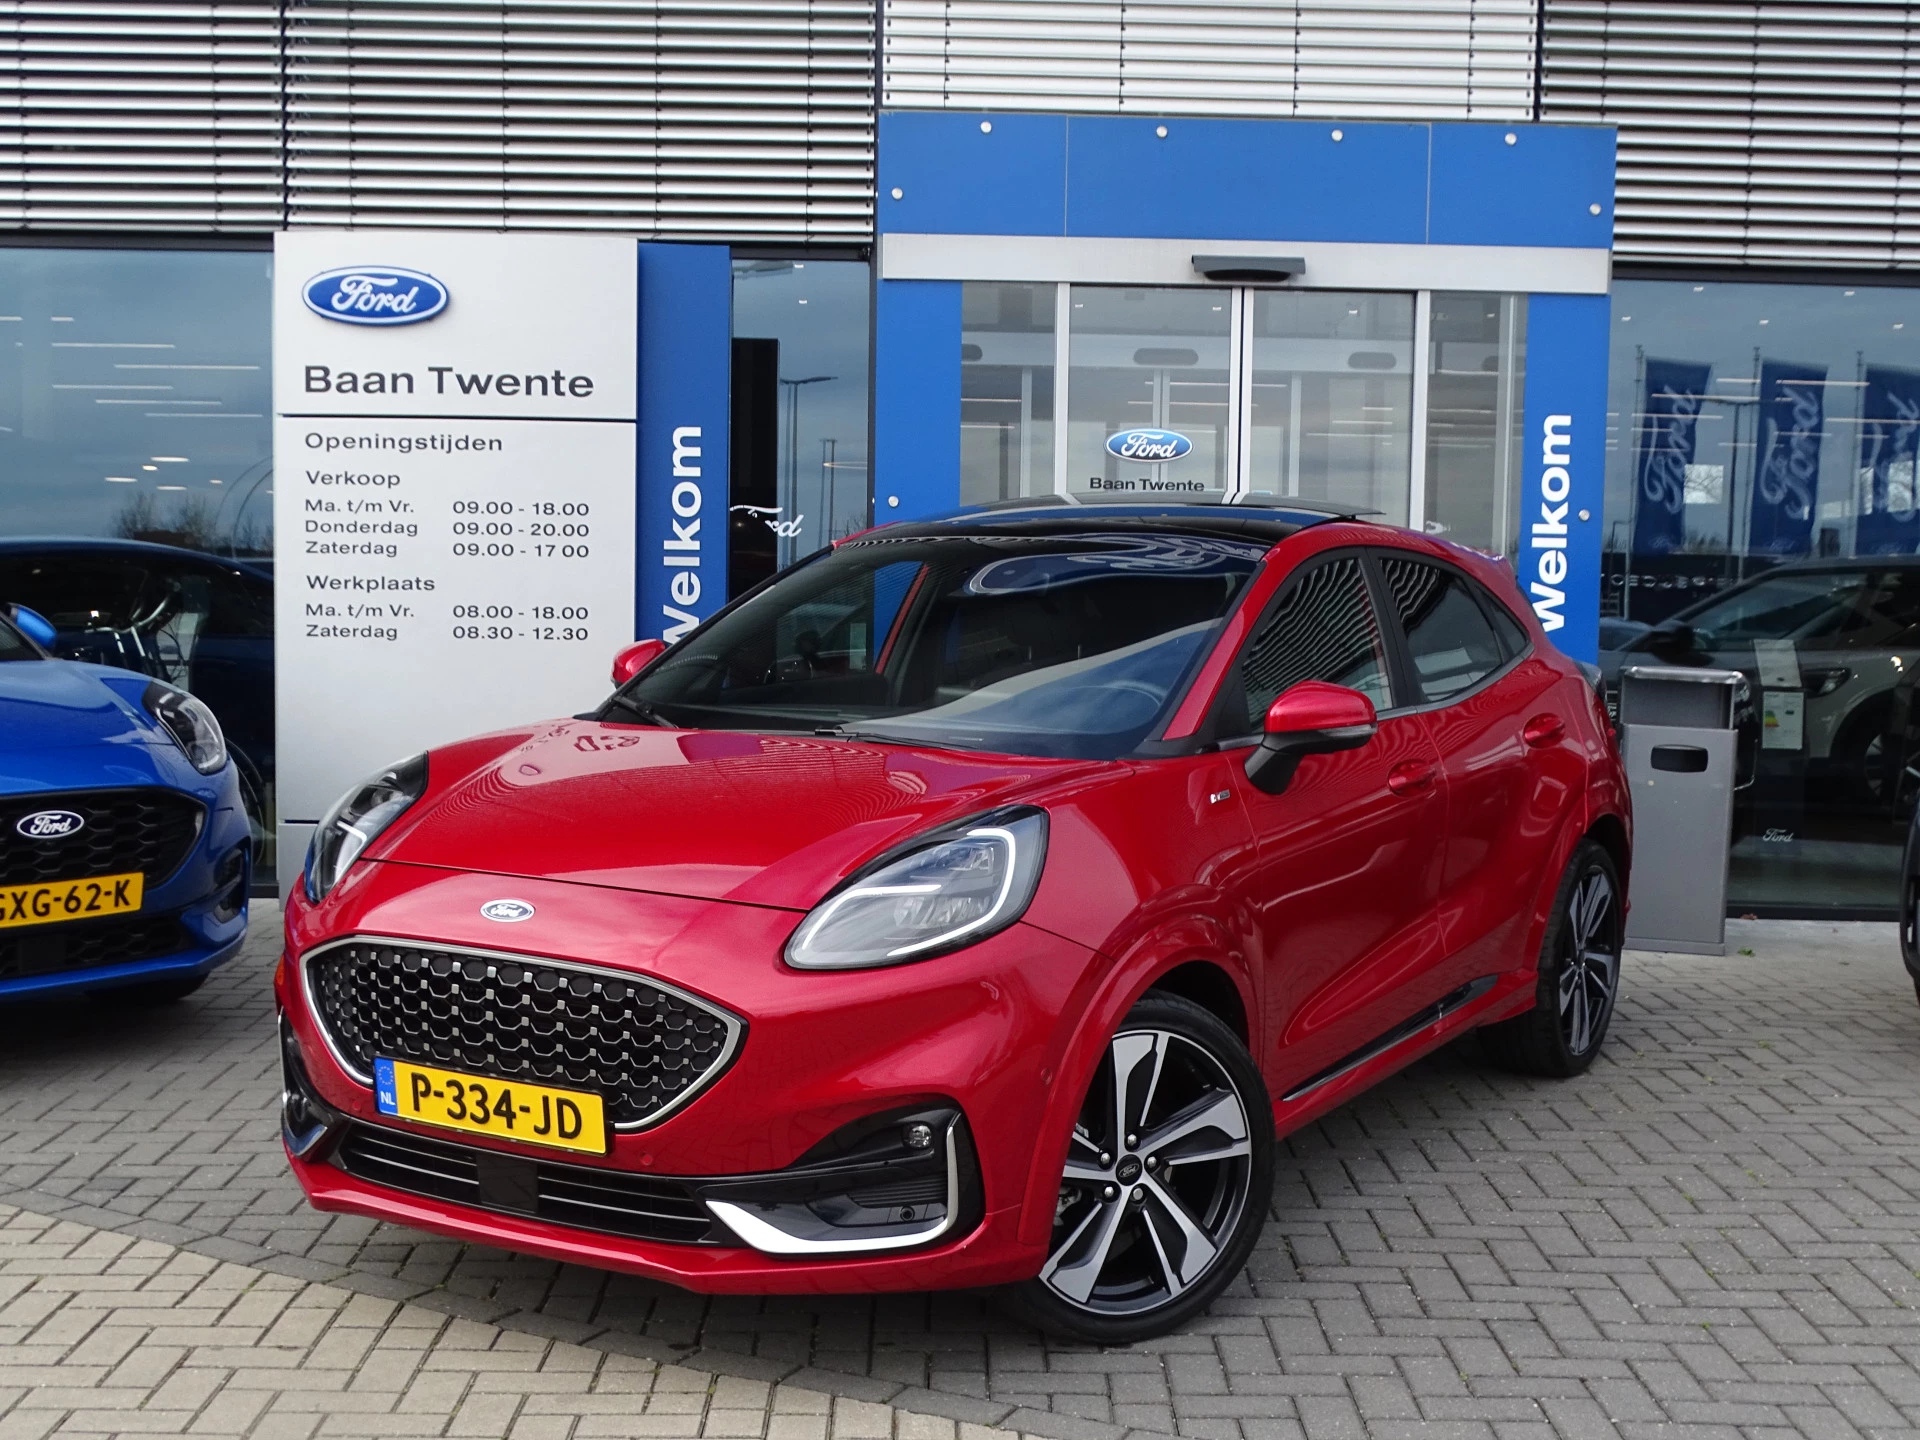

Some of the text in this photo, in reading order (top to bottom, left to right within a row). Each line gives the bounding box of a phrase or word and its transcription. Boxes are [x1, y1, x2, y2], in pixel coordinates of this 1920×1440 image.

[331, 273, 418, 314] Ford
[304, 364, 595, 399] Baan Twente
[304, 432, 503, 455] Openingstijden
[1120, 431, 1178, 458] Ford
[305, 470, 401, 490] Verkoop
[1089, 476, 1205, 492] Baan Twente
[305, 499, 342, 513] Ma.
[346, 499, 383, 515] t/m
[389, 500, 415, 513] Vr.
[452, 501, 514, 515] 09.00
[531, 502, 590, 516] 18.00
[305, 519, 418, 538] Donderdag
[452, 521, 514, 537] 09.00
[530, 522, 590, 537] 20.00
[1530, 414, 1572, 633] Welkom
[663, 425, 703, 646] Welkom
[305, 540, 398, 559] Zaterdag
[452, 542, 515, 557] 09.00
[305, 575, 436, 593] Werkplaats
[305, 603, 342, 617] Ma.
[347, 603, 383, 619] t/m
[389, 604, 415, 618] Vr.
[452, 604, 514, 619] 08.00
[531, 605, 590, 620] 18.00
[305, 623, 398, 642] Zaterdag
[452, 625, 514, 640] 08.30
[532, 626, 590, 641] 12.30
[29, 813, 73, 835] Ford
[1762, 827, 1795, 843] Ford
[380, 1071, 583, 1140] NL P-334-JD
